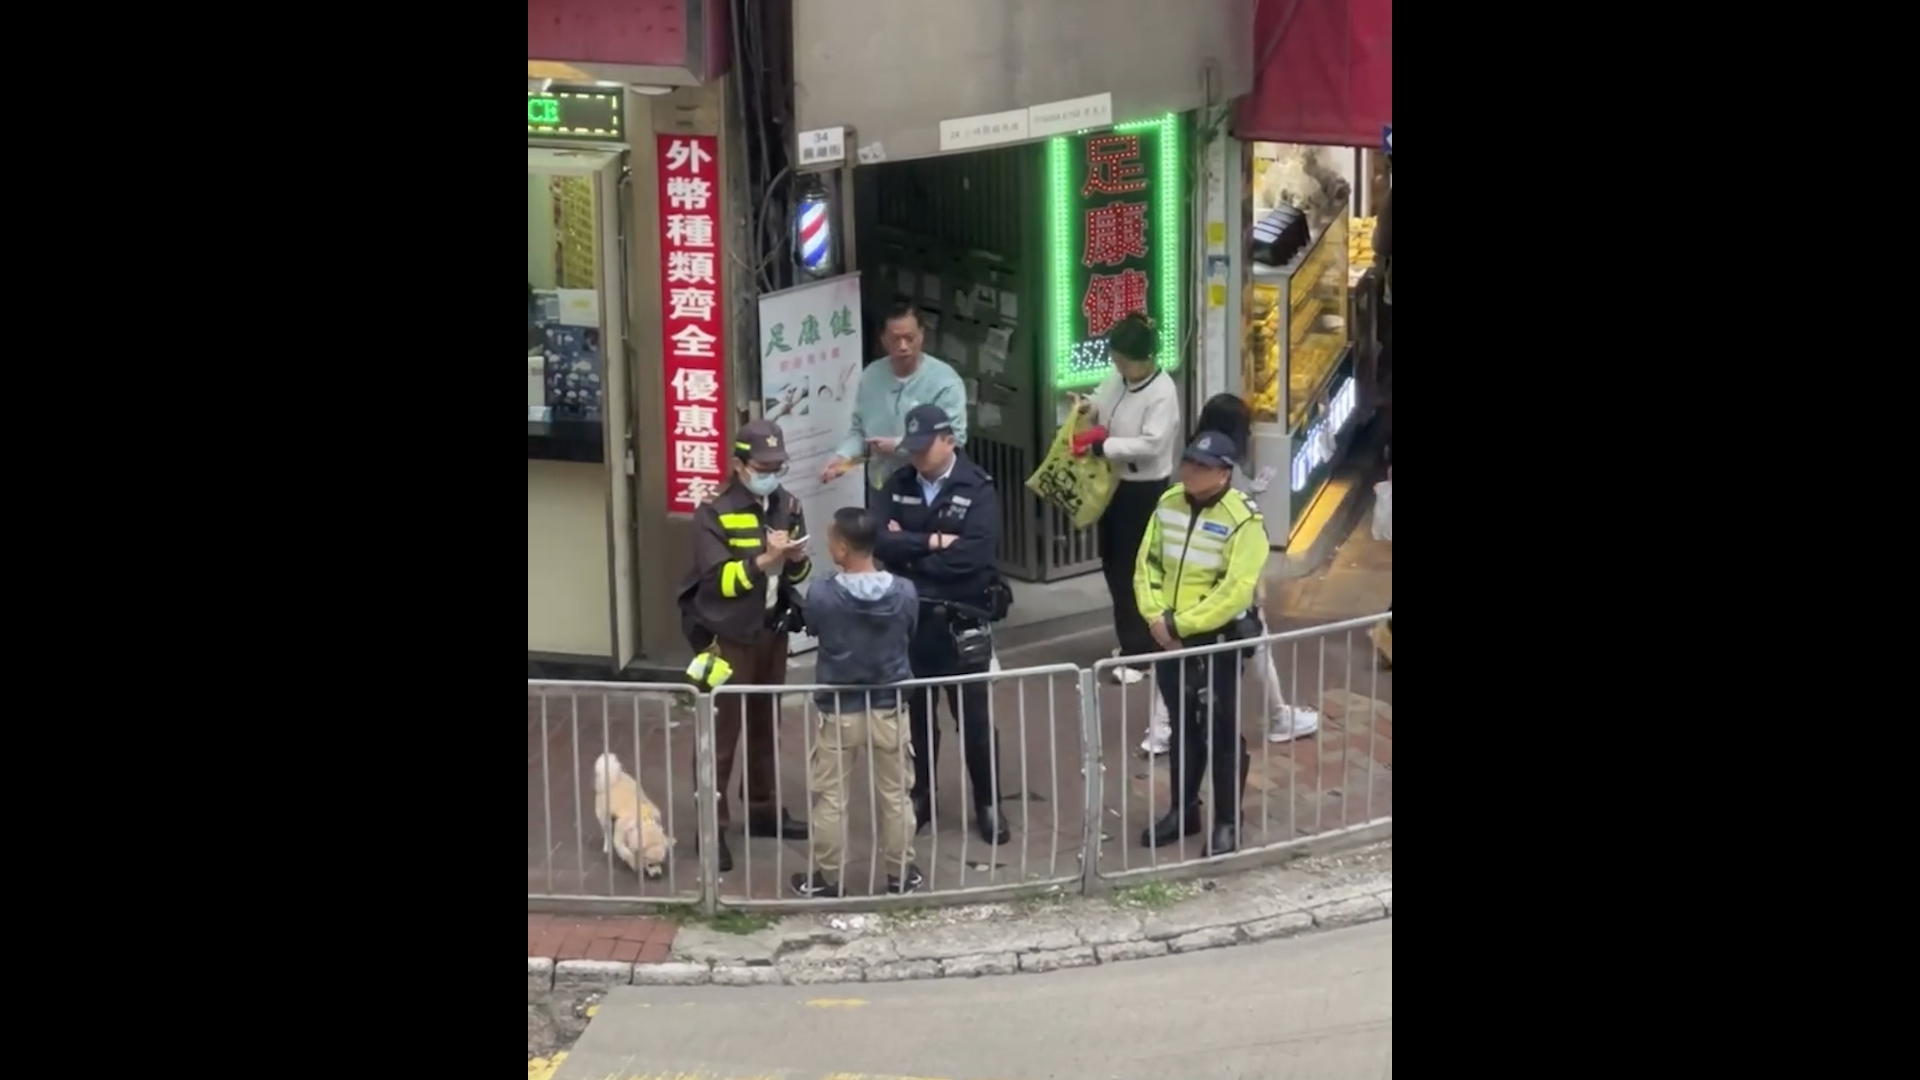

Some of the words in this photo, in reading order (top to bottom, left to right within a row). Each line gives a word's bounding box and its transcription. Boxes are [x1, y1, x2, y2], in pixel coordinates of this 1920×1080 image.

[814, 131, 829, 143] 34
[665, 139, 716, 358] 外幣種類齊全
[1082, 133, 1149, 336] 足康健
[764, 304, 857, 358] 足康健
[671, 367, 720, 509] 優惠匯率
